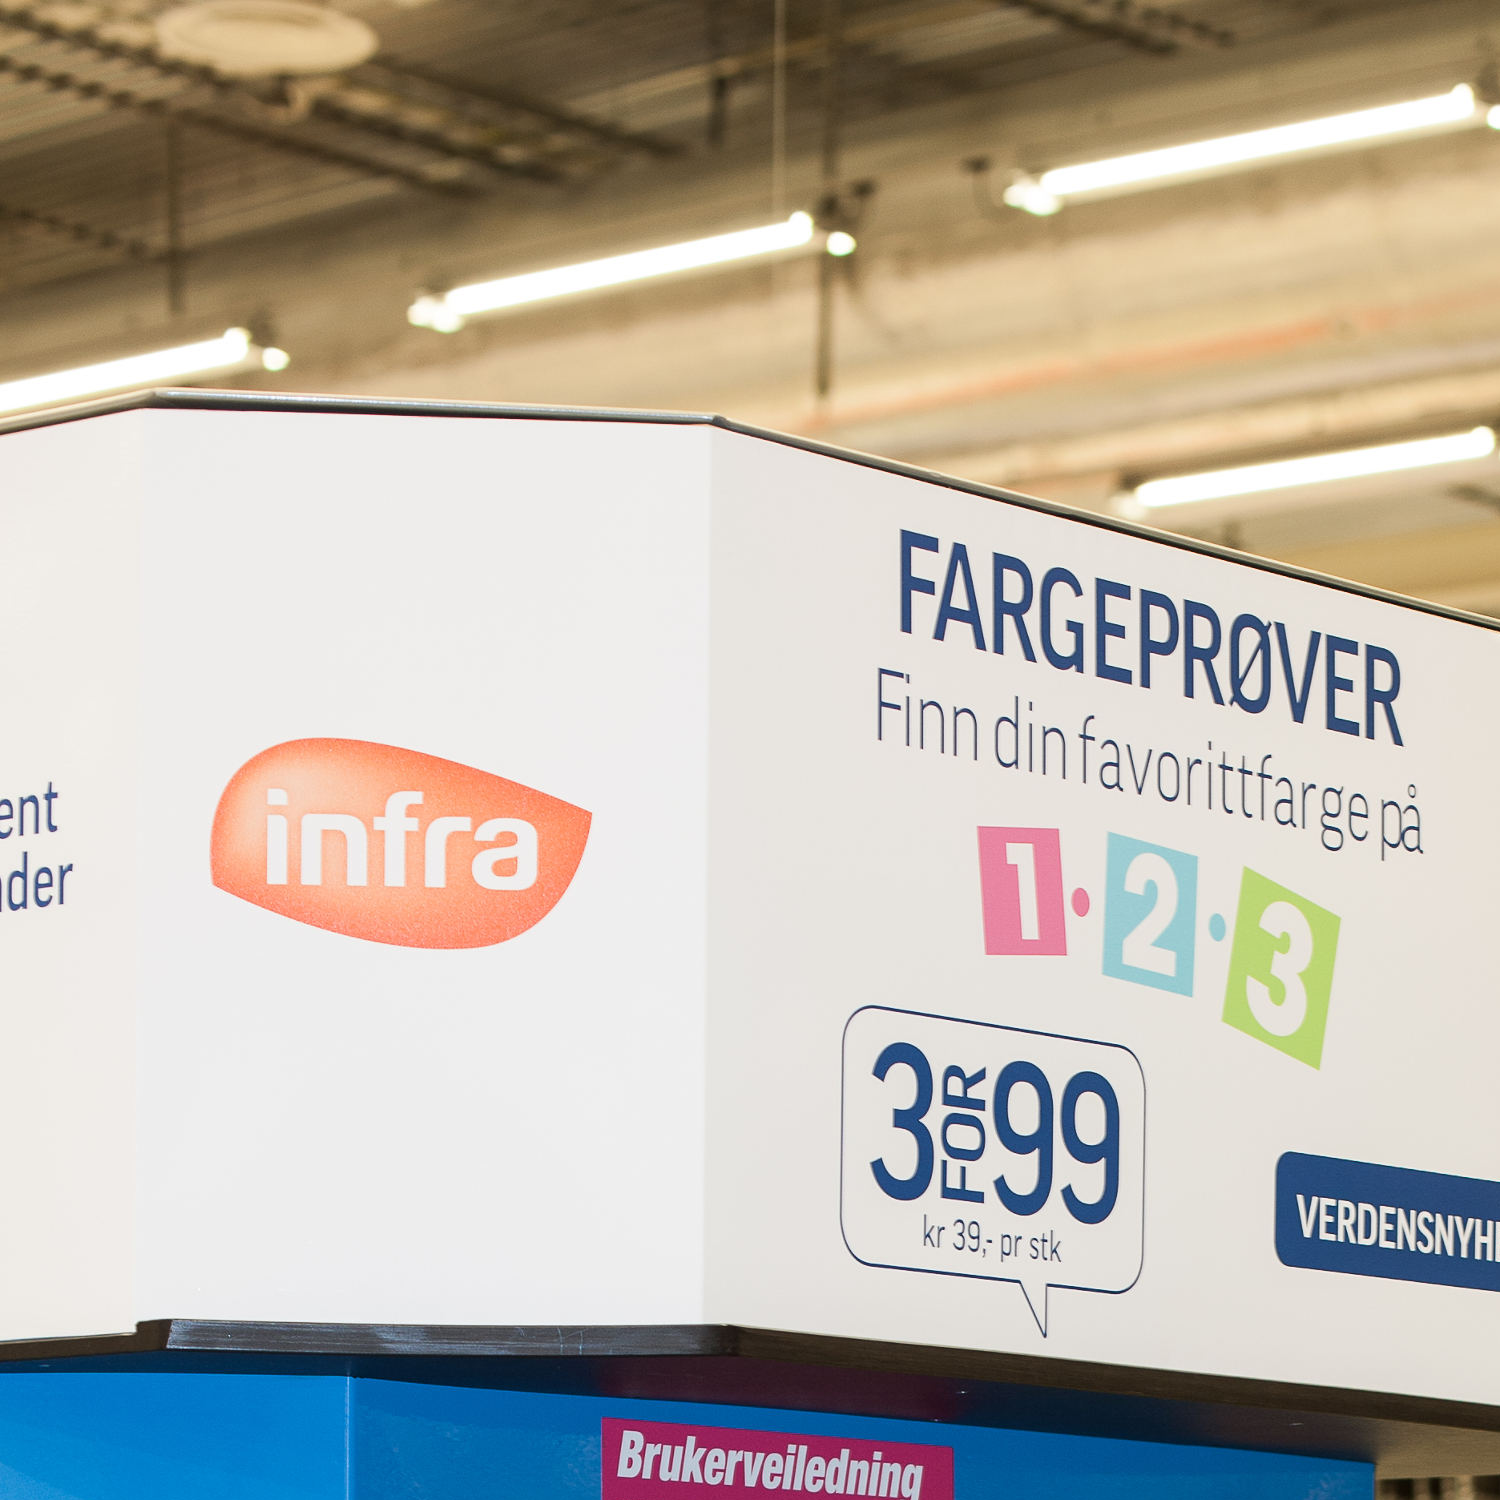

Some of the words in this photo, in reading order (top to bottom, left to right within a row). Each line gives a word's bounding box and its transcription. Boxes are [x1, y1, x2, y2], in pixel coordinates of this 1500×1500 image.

[898, 529, 1404, 747] FARGEPRØVER
[876, 667, 978, 761] Finn
[993, 696, 1066, 780] din
[1078, 715, 1369, 853] favorittfarge
[1380, 784, 1425, 862] på
[0, 851, 73, 912] der
[266, 788, 540, 892] infra
[870, 1041, 935, 1202] 3
[940, 1064, 986, 1204] FOR
[993, 1061, 1122, 1225] 99
[923, 1214, 946, 1249] kr
[953, 1219, 993, 1258] 39,-
[1000, 1233, 1023, 1263] pr
[1029, 1230, 1062, 1263] stk
